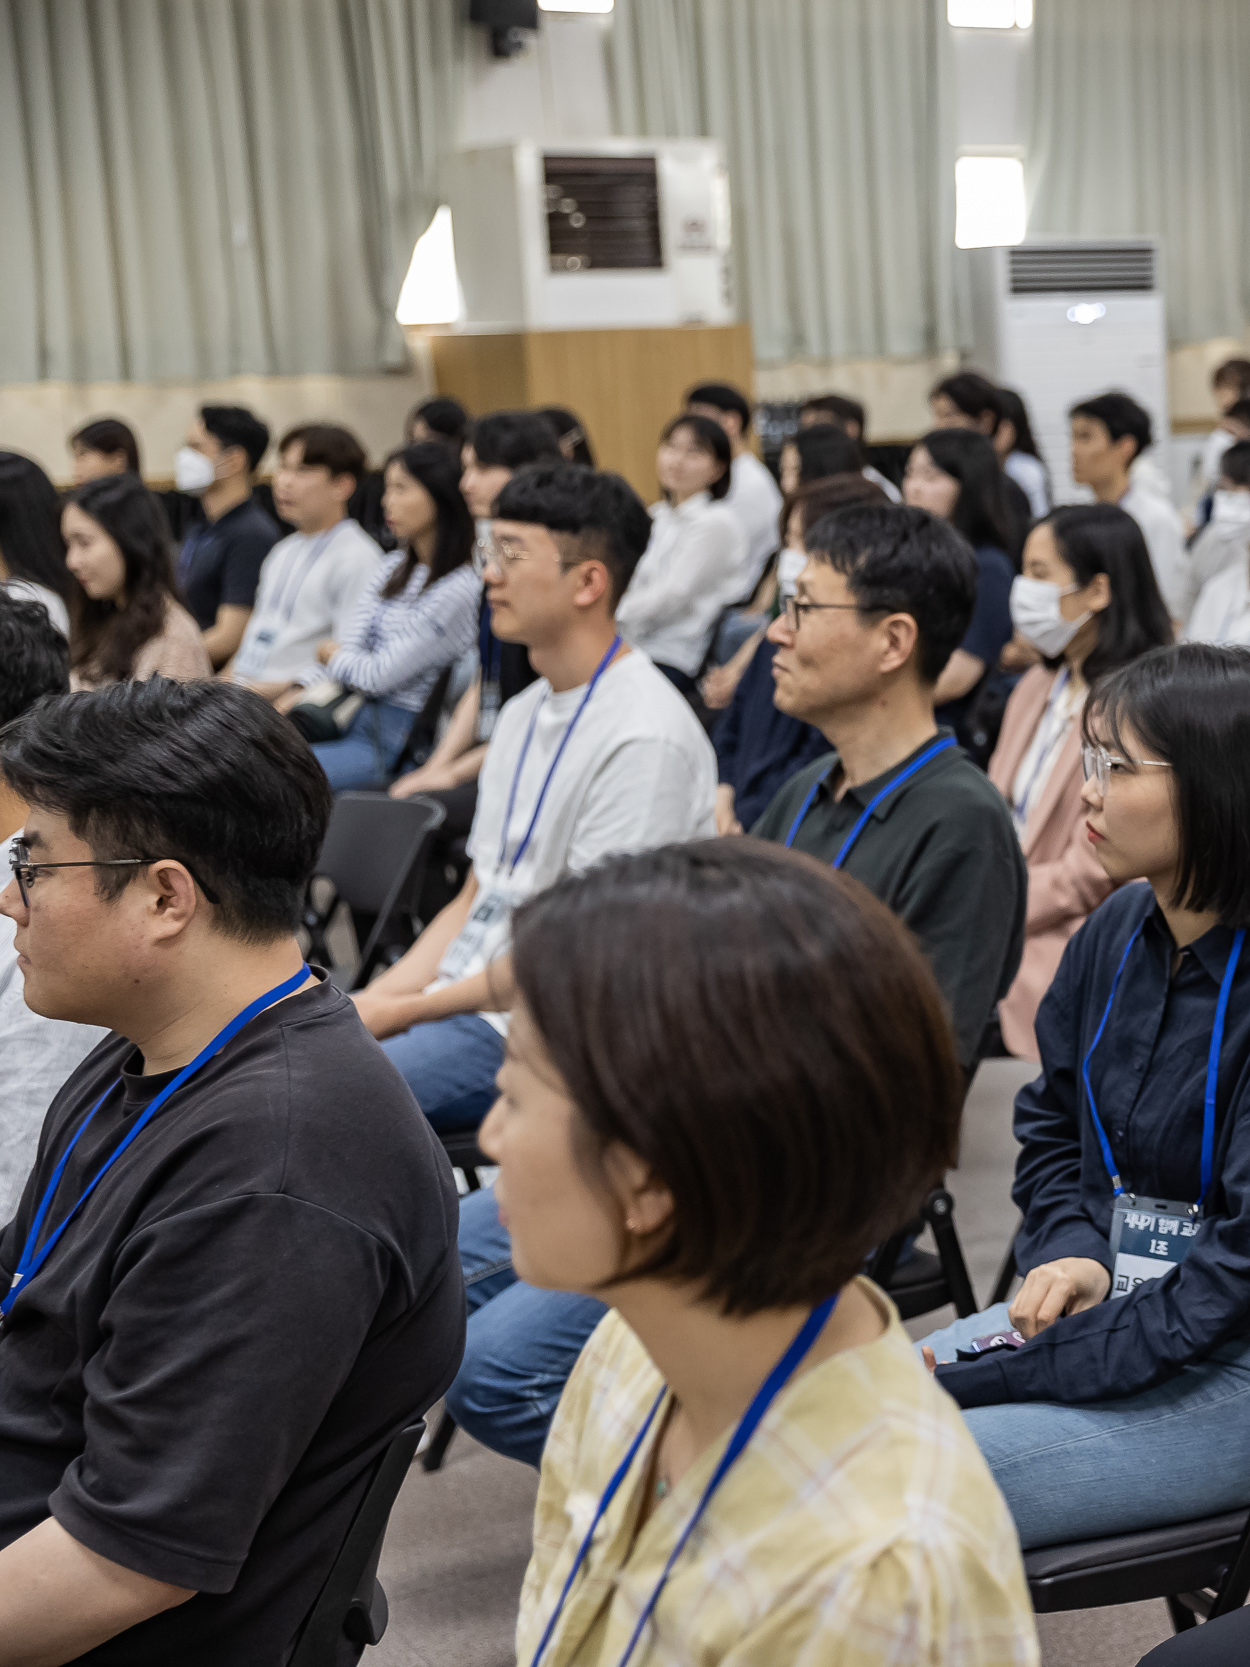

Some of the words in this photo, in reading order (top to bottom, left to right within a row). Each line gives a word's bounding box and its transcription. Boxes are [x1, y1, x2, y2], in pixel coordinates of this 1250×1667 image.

[1124, 1213, 1156, 1231] 새내기
[1157, 1218, 1179, 1235] 함께
[1148, 1239, 1168, 1255] 1조
